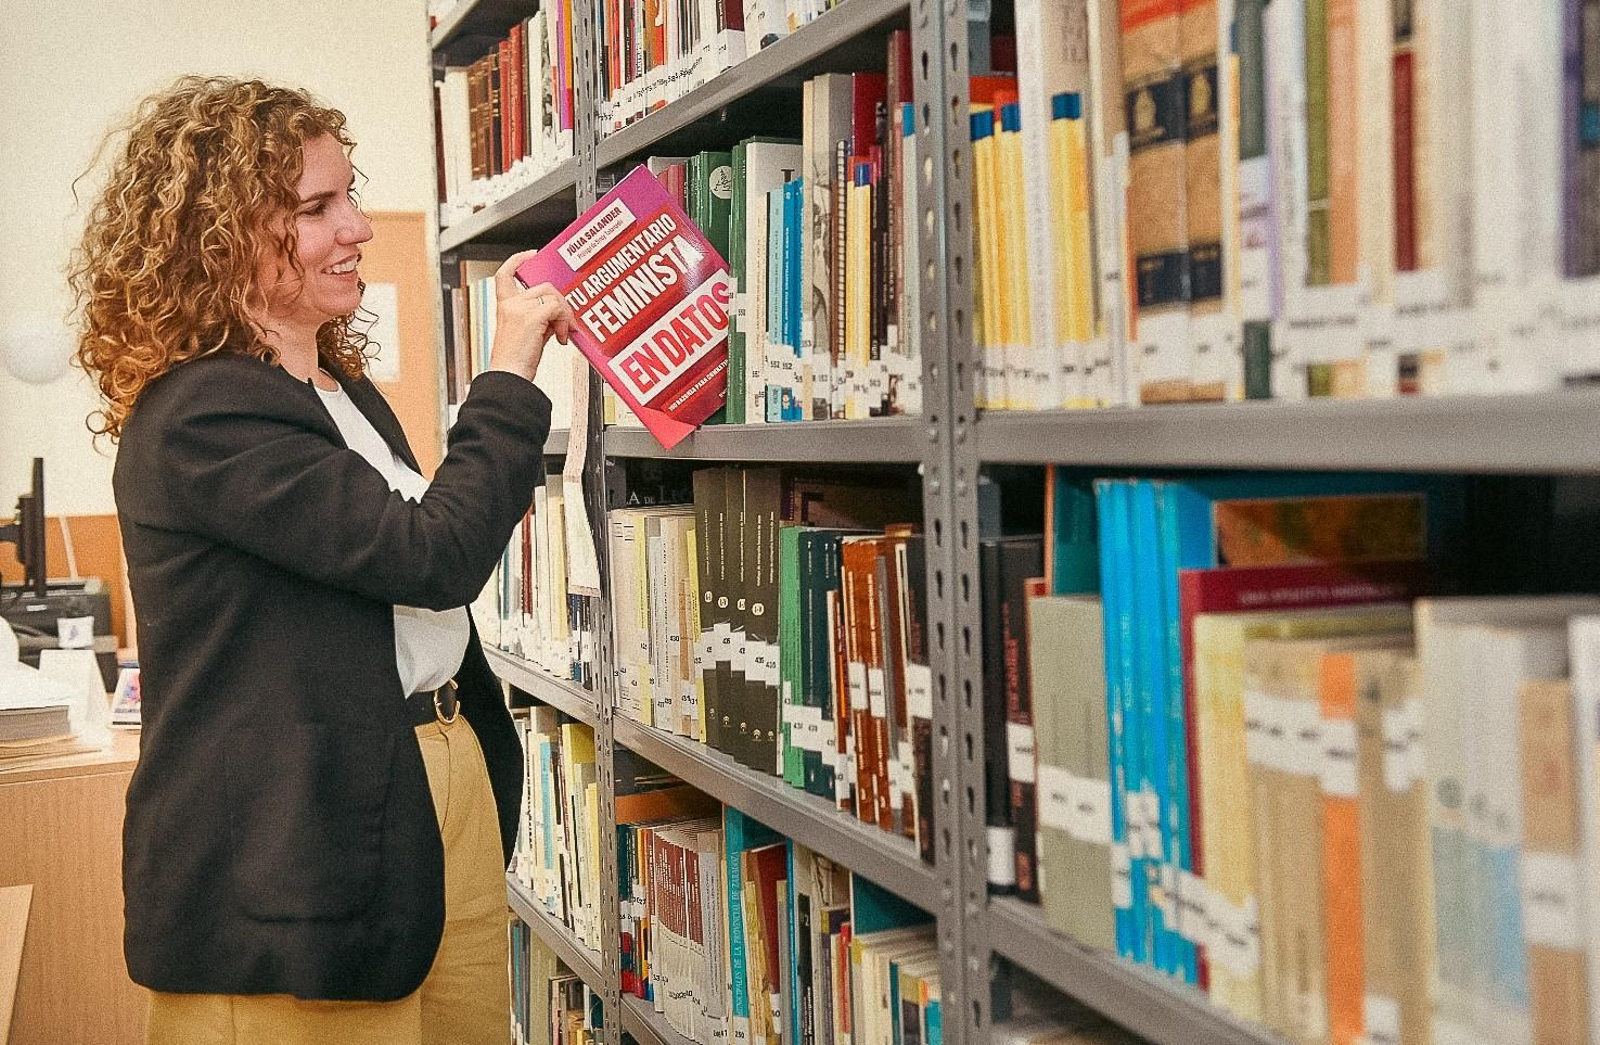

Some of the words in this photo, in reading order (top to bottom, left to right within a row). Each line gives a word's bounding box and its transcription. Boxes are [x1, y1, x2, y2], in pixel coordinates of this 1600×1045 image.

[566, 238, 587, 256] JÚLIA
[585, 206, 622, 239] SALANDER
[564, 287, 588, 311] TU
[582, 213, 677, 298] ARGUMENTARIO
[581, 234, 705, 344] FEMINISTA
[619, 343, 670, 394] EN
[734, 946, 742, 956] LA
